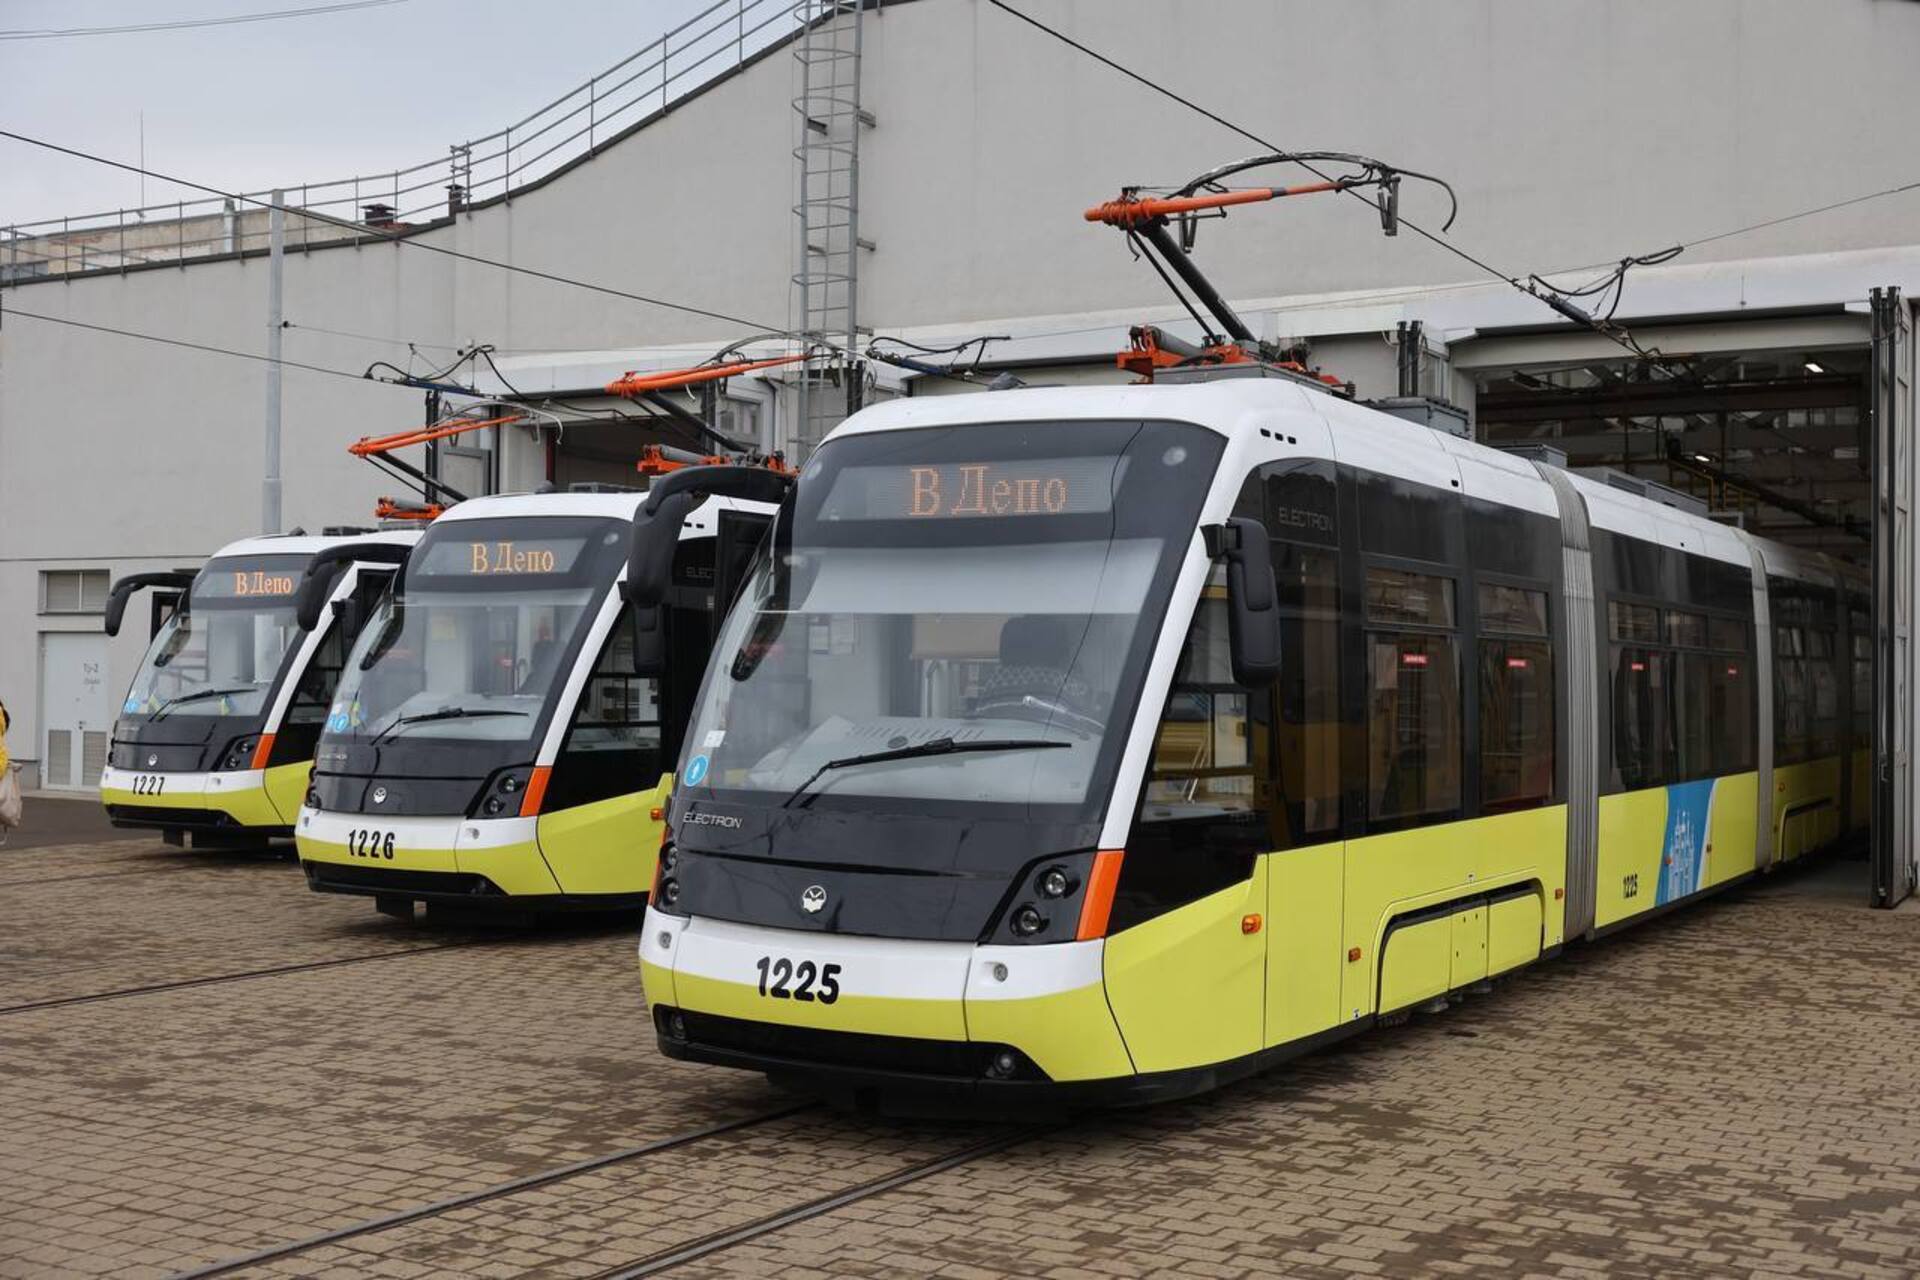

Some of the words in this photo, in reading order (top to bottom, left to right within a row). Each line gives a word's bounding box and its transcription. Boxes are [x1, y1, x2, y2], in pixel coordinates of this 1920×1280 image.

[909, 468, 940, 516] В
[951, 465, 1068, 516] Депо
[470, 542, 489, 573] В
[493, 542, 554, 573] Депо
[234, 571, 247, 595] В
[250, 571, 292, 595] Депо
[132, 775, 165, 797] 1227
[683, 812, 742, 829] ELECTRON
[348, 829, 396, 861] 1226
[757, 956, 842, 1005] 1225
